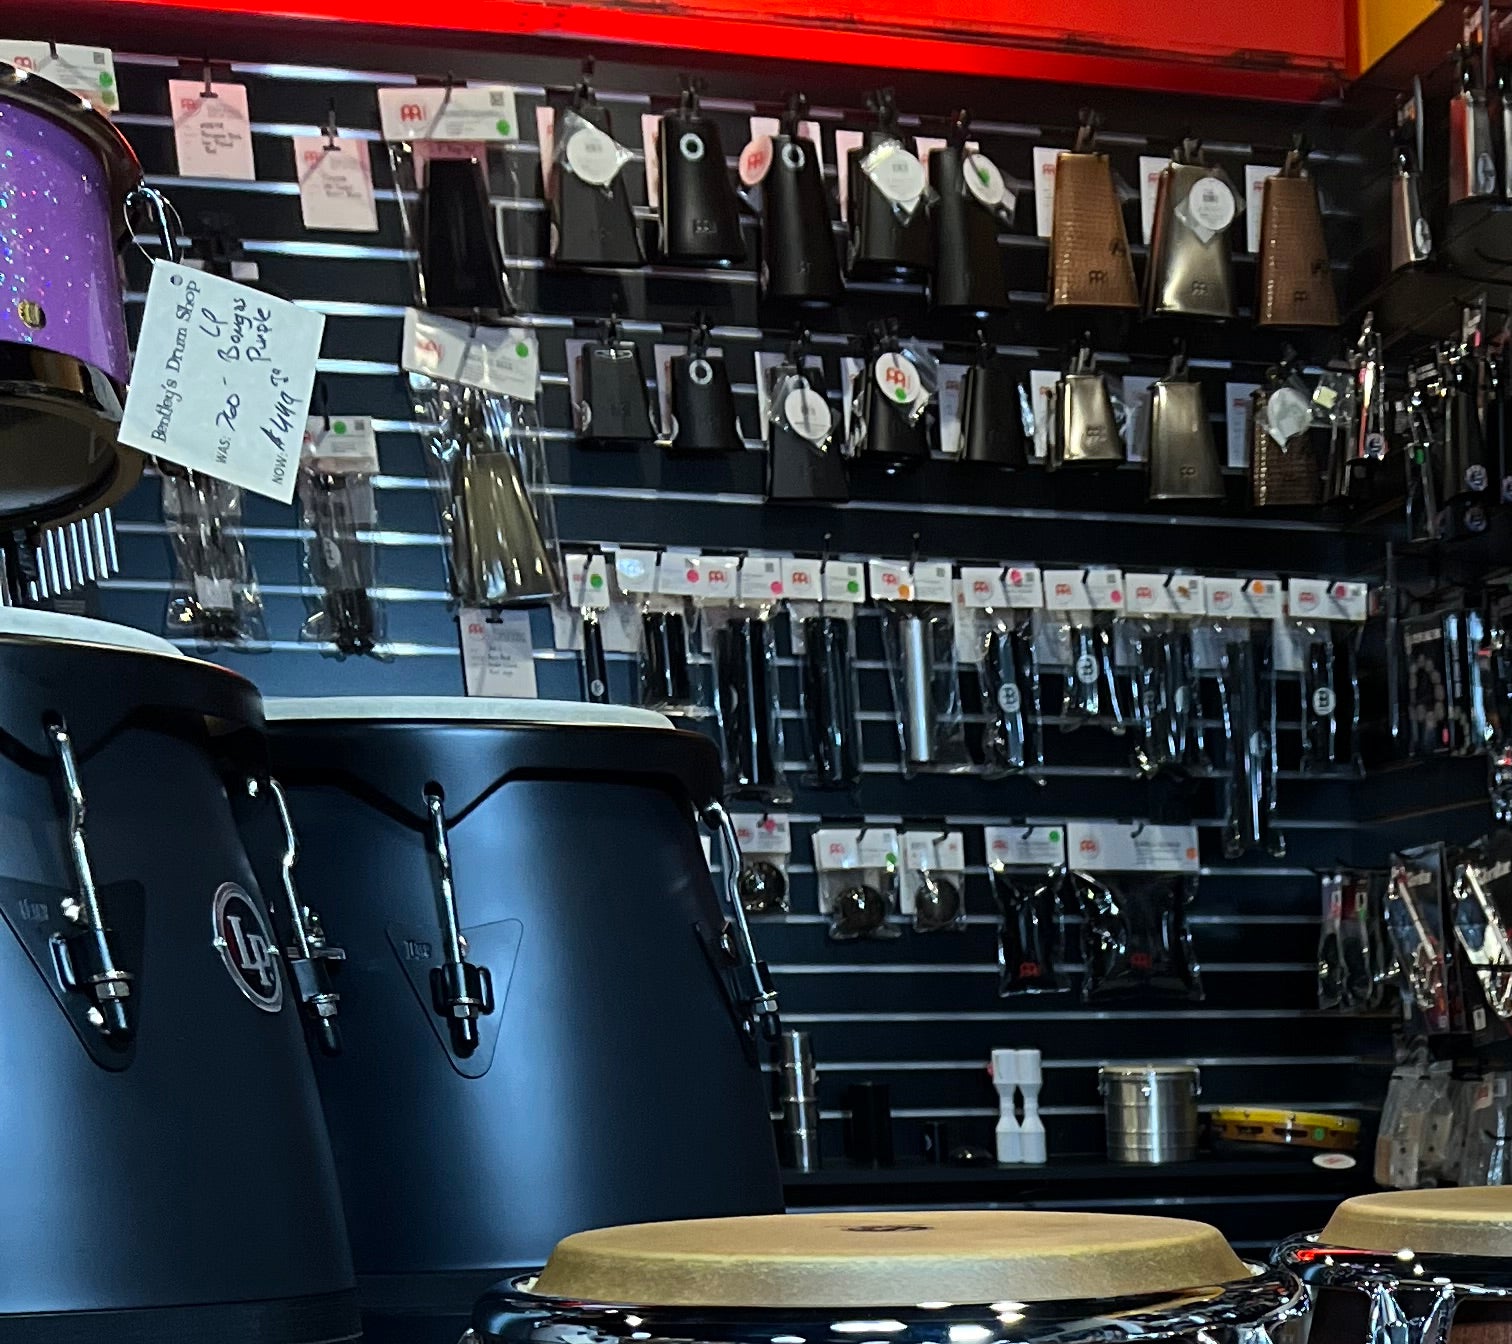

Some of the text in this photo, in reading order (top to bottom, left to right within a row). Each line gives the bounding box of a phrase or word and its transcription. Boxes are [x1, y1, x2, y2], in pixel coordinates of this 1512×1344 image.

[151, 280, 201, 443] Bentley's Drum Shop
[216, 435, 232, 464] WAS:
[271, 450, 289, 486] NOW:
